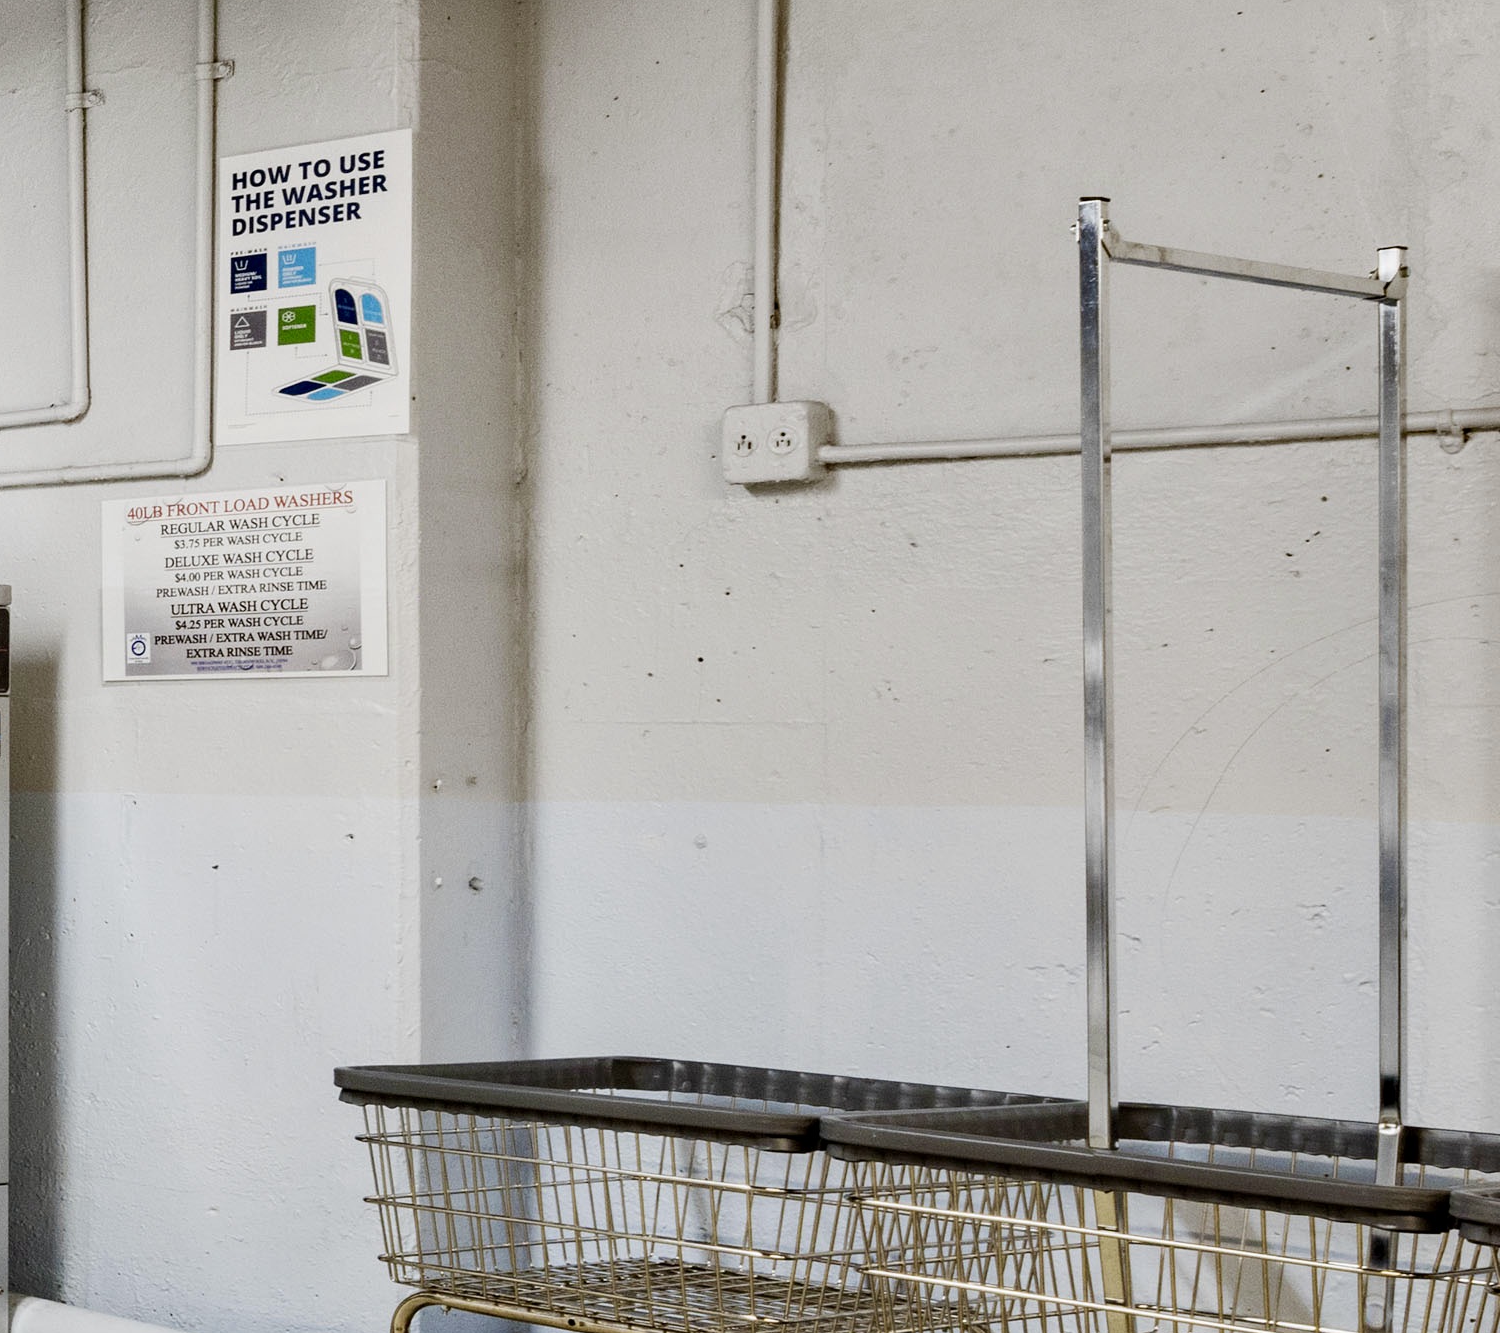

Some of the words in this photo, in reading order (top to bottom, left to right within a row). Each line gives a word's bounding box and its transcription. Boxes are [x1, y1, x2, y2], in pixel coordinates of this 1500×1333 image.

[232, 164, 291, 191] HOW
[298, 159, 331, 180] TO
[340, 150, 385, 174] USE
[231, 190, 275, 213] THE
[282, 174, 388, 206] WASHER
[232, 202, 362, 237] DISPENSER
[230, 248, 268, 256] PRE-WASH
[127, 505, 163, 520] 40LB
[166, 500, 220, 517] FRONT
[224, 497, 269, 513] LOAD
[273, 490, 353, 508] WASHERS
[160, 520, 225, 535] REGULAR
[229, 516, 268, 530] WASH
[272, 513, 320, 527] CYCLE
[174, 538, 200, 550] $3.75
[203, 536, 224, 547] PER
[227, 534, 260, 545] WASH
[262, 531, 303, 544] CYCLE
[165, 554, 220, 568] DELUXE
[222, 551, 262, 564] WASH
[265, 548, 314, 562] CYCLE
[174, 572, 201, 583] $4.00
[203, 570, 224, 581] PER
[227, 569, 260, 579] WASH
[263, 566, 303, 578] CYCLE
[156, 586, 209, 598] PREWASH
[218, 584, 257, 595] EXTRA
[259, 582, 294, 593] RINSE
[296, 580, 327, 591] TIME
[171, 602, 215, 615] ULTRA
[217, 600, 257, 613] WASH
[260, 597, 308, 611] CYCLE
[175, 619, 201, 631] $4.25
[204, 618, 225, 629] PER
[228, 617, 261, 628] WASH
[263, 615, 304, 626] CYCLE
[154, 634, 207, 645] PREWASH
[216, 632, 255, 643] EXTRA
[257, 630, 291, 641] WASH
[293, 629, 328, 640] TIME/
[186, 647, 225, 659] EXTRA
[227, 647, 261, 657] RINSE
[263, 645, 294, 656] TIME
